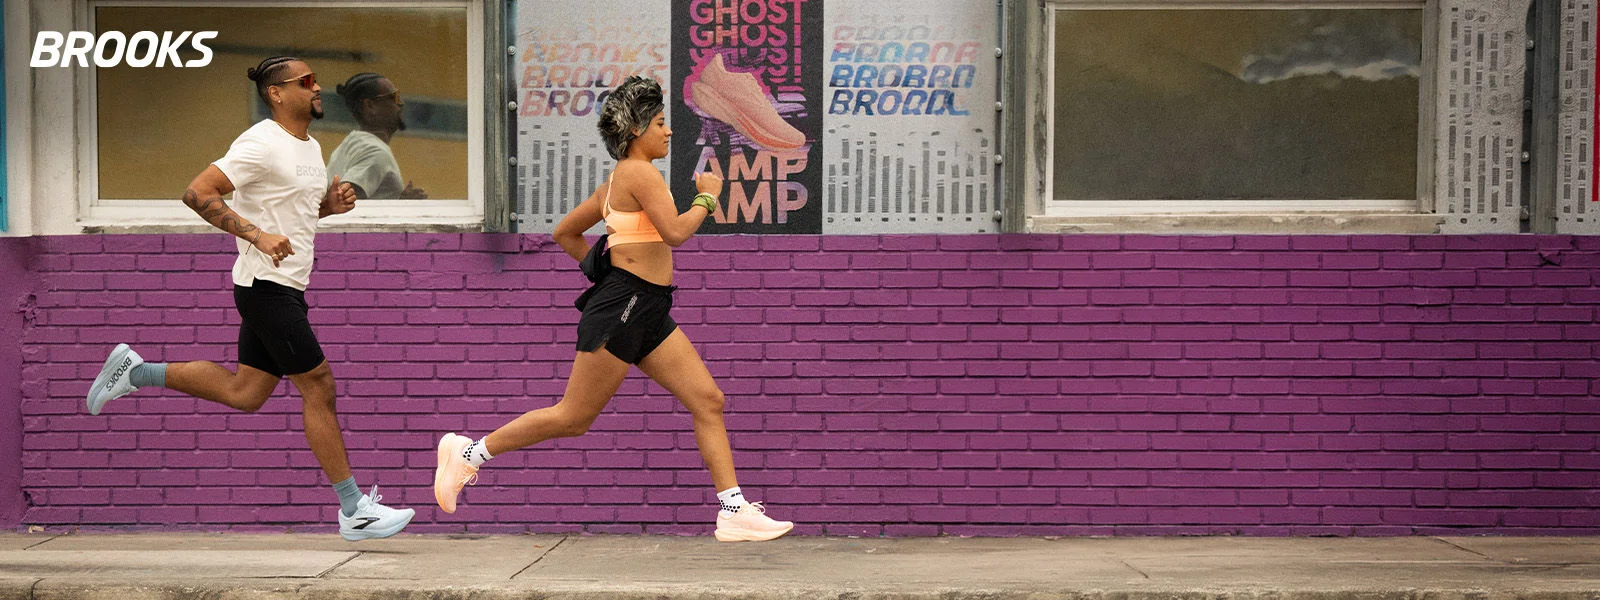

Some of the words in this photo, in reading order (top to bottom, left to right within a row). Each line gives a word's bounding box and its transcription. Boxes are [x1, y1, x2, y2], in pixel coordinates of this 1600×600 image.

[689, 0, 807, 24] GHOST
[691, 146, 808, 181] AMP
[106, 357, 132, 392] BROOKS
